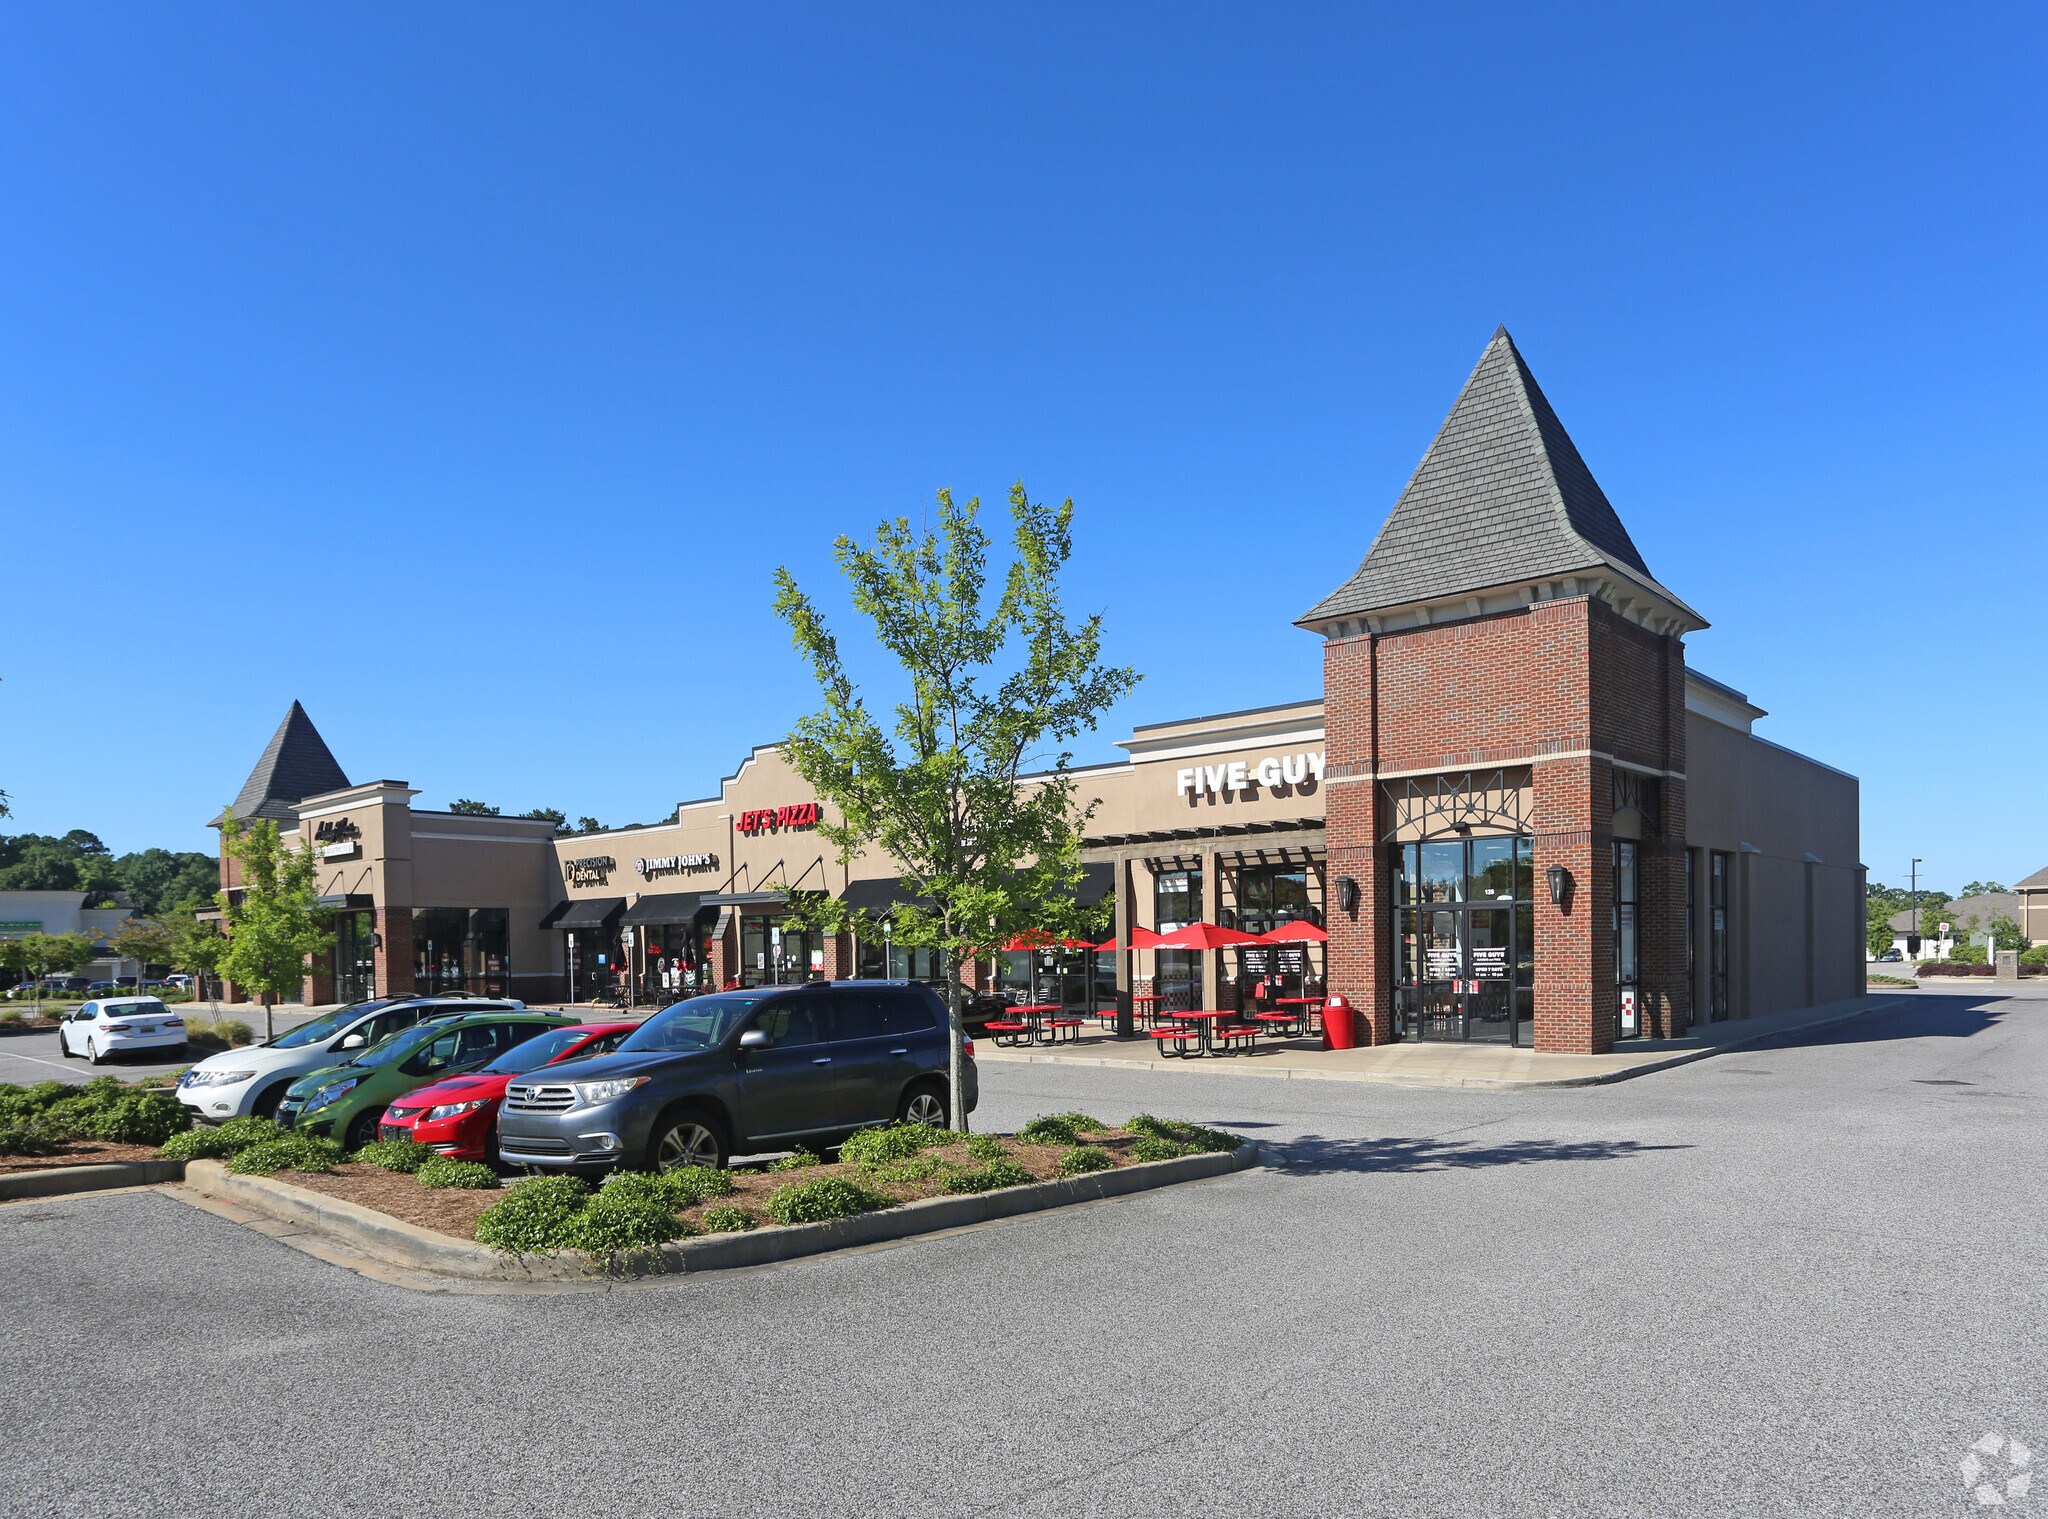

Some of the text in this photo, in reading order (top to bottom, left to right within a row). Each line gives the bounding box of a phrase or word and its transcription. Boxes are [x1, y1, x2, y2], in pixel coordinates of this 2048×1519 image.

[1176, 761, 1249, 796] FIVE
[736, 803, 817, 832] JET'S PIZZA
[575, 856, 608, 869] PRECISION
[645, 857, 676, 873] JIMMY
[678, 853, 711, 869] JOHN'S
[575, 868, 600, 881] DENTAL
